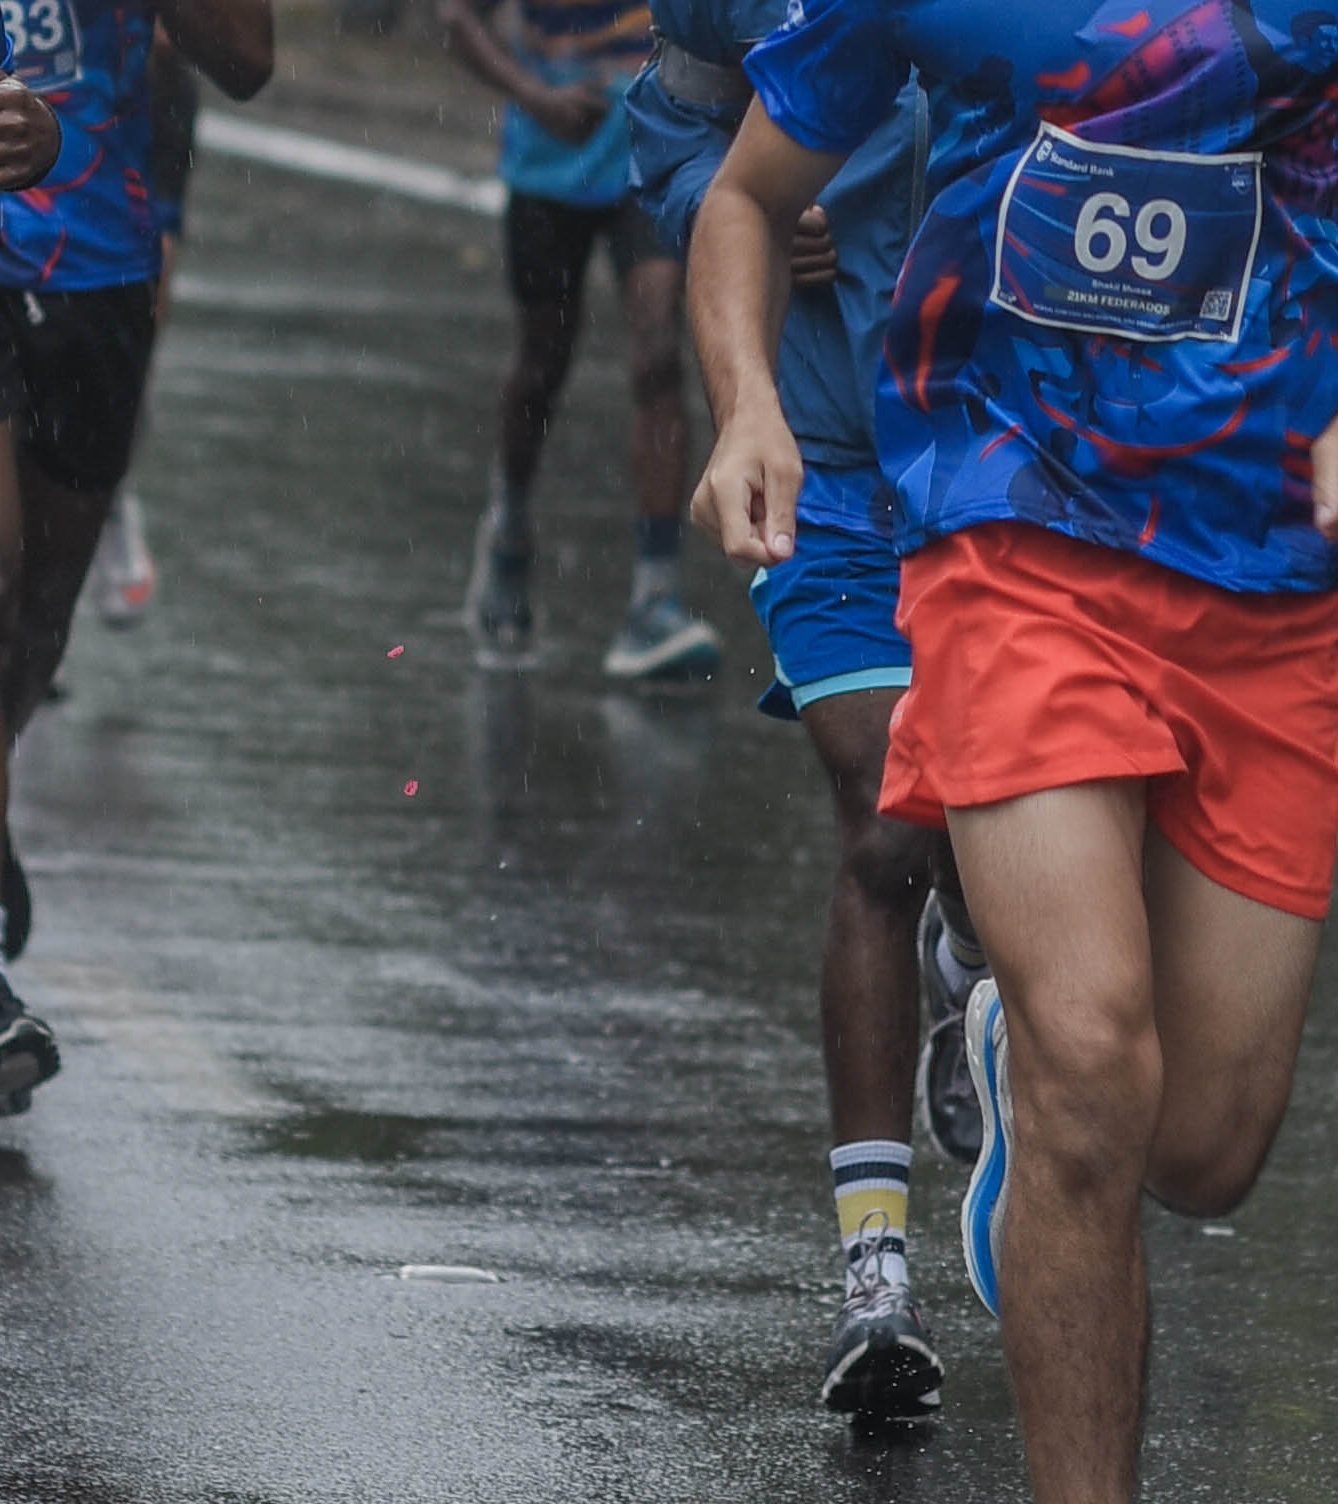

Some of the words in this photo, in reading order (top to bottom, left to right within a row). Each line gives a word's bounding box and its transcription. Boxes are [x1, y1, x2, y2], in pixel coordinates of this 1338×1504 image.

[1050, 151, 1088, 174] Standard
[1089, 163, 1115, 177] Bank
[1074, 191, 1187, 281] 69
[1067, 289, 1099, 306] 21KM
[1100, 295, 1171, 316] FEDERADOS
